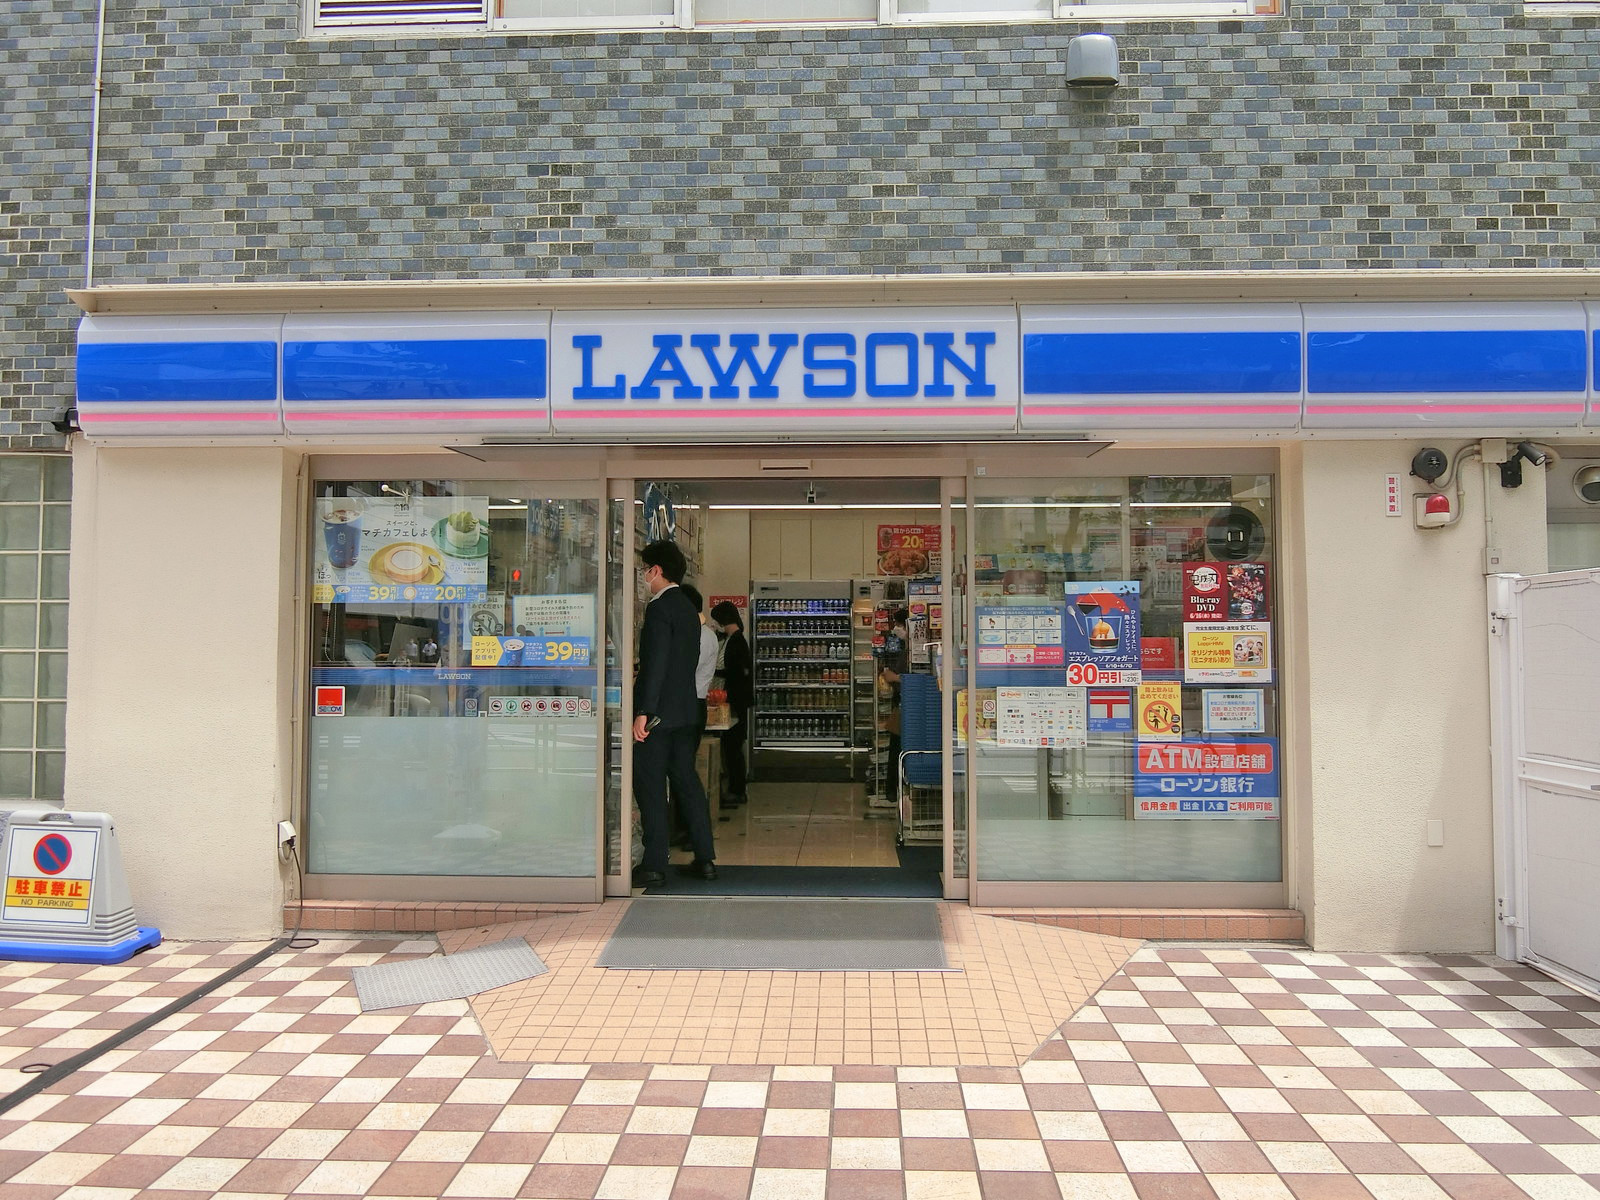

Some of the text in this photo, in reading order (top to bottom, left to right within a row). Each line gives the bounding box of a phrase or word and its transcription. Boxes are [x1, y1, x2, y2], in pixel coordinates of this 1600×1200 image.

[572, 332, 996, 400] LAWSON
[1190, 596, 1221, 604] Blu-ray
[1196, 604, 1215, 612] DVD
[545, 641, 573, 661] 39
[1146, 749, 1266, 769] ATM設置店舗
[1160, 777, 1255, 793] ローソン銀行
[1140, 802, 1273, 811] 信用金庫 出金 入金 ご利用可能
[15, 879, 83, 897] 駐車禁止
[37, 899, 74, 907] PARKING
